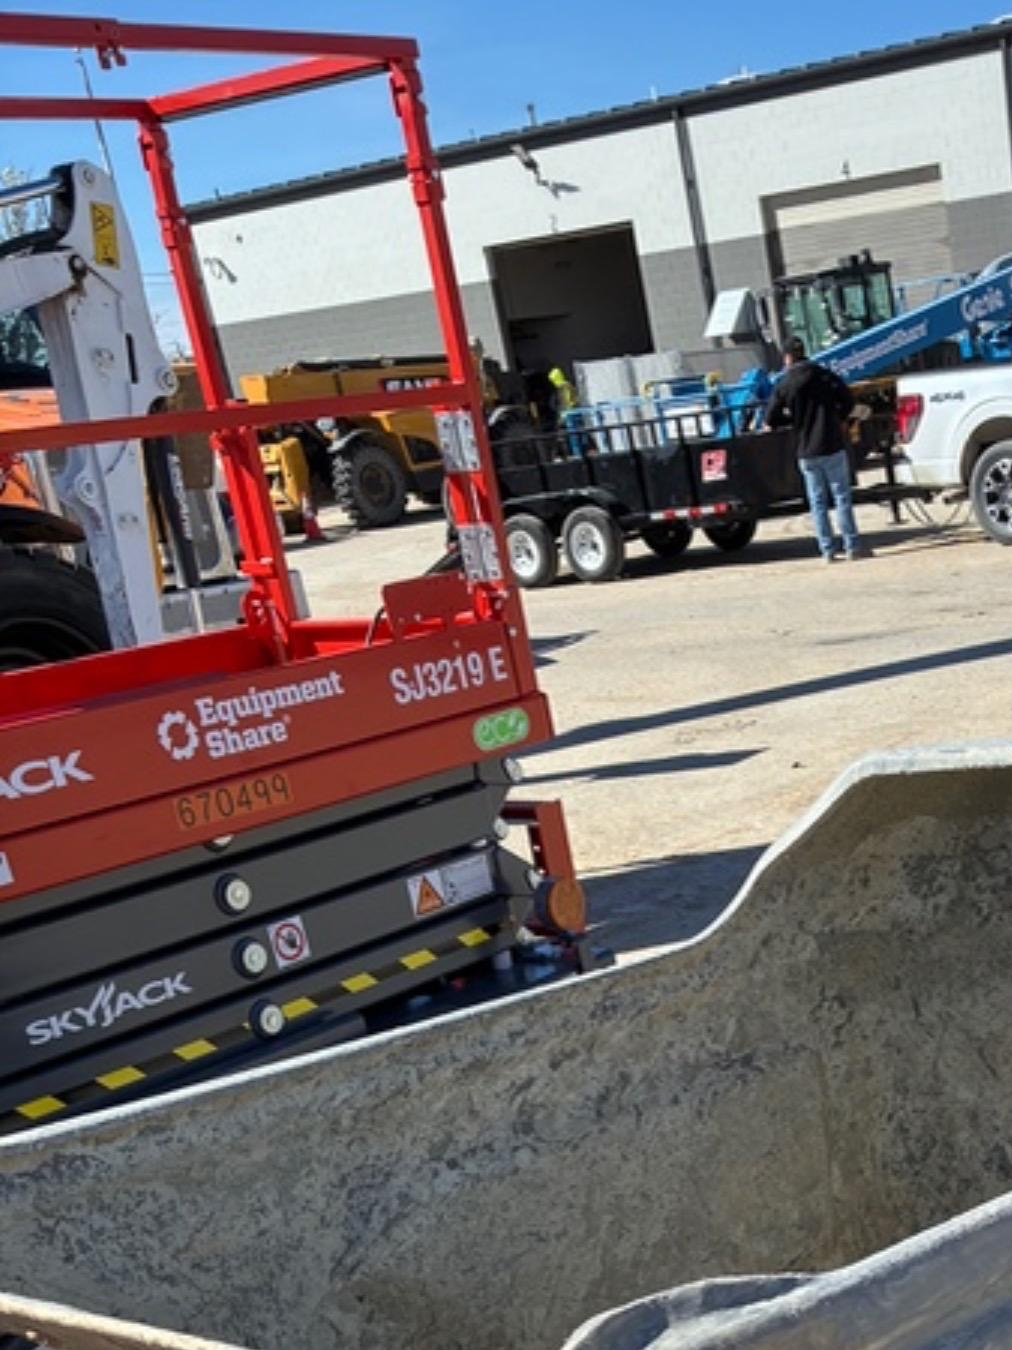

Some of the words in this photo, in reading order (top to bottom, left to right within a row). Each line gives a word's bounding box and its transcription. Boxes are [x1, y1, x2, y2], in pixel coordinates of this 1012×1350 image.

[194, 670, 345, 727] Equipment
[389, 651, 486, 704] SJ3219
[487, 647, 508, 682] E
[205, 719, 288, 759] Share
[176, 773, 290, 829] 670499
[25, 971, 193, 1046] SKYJACK
